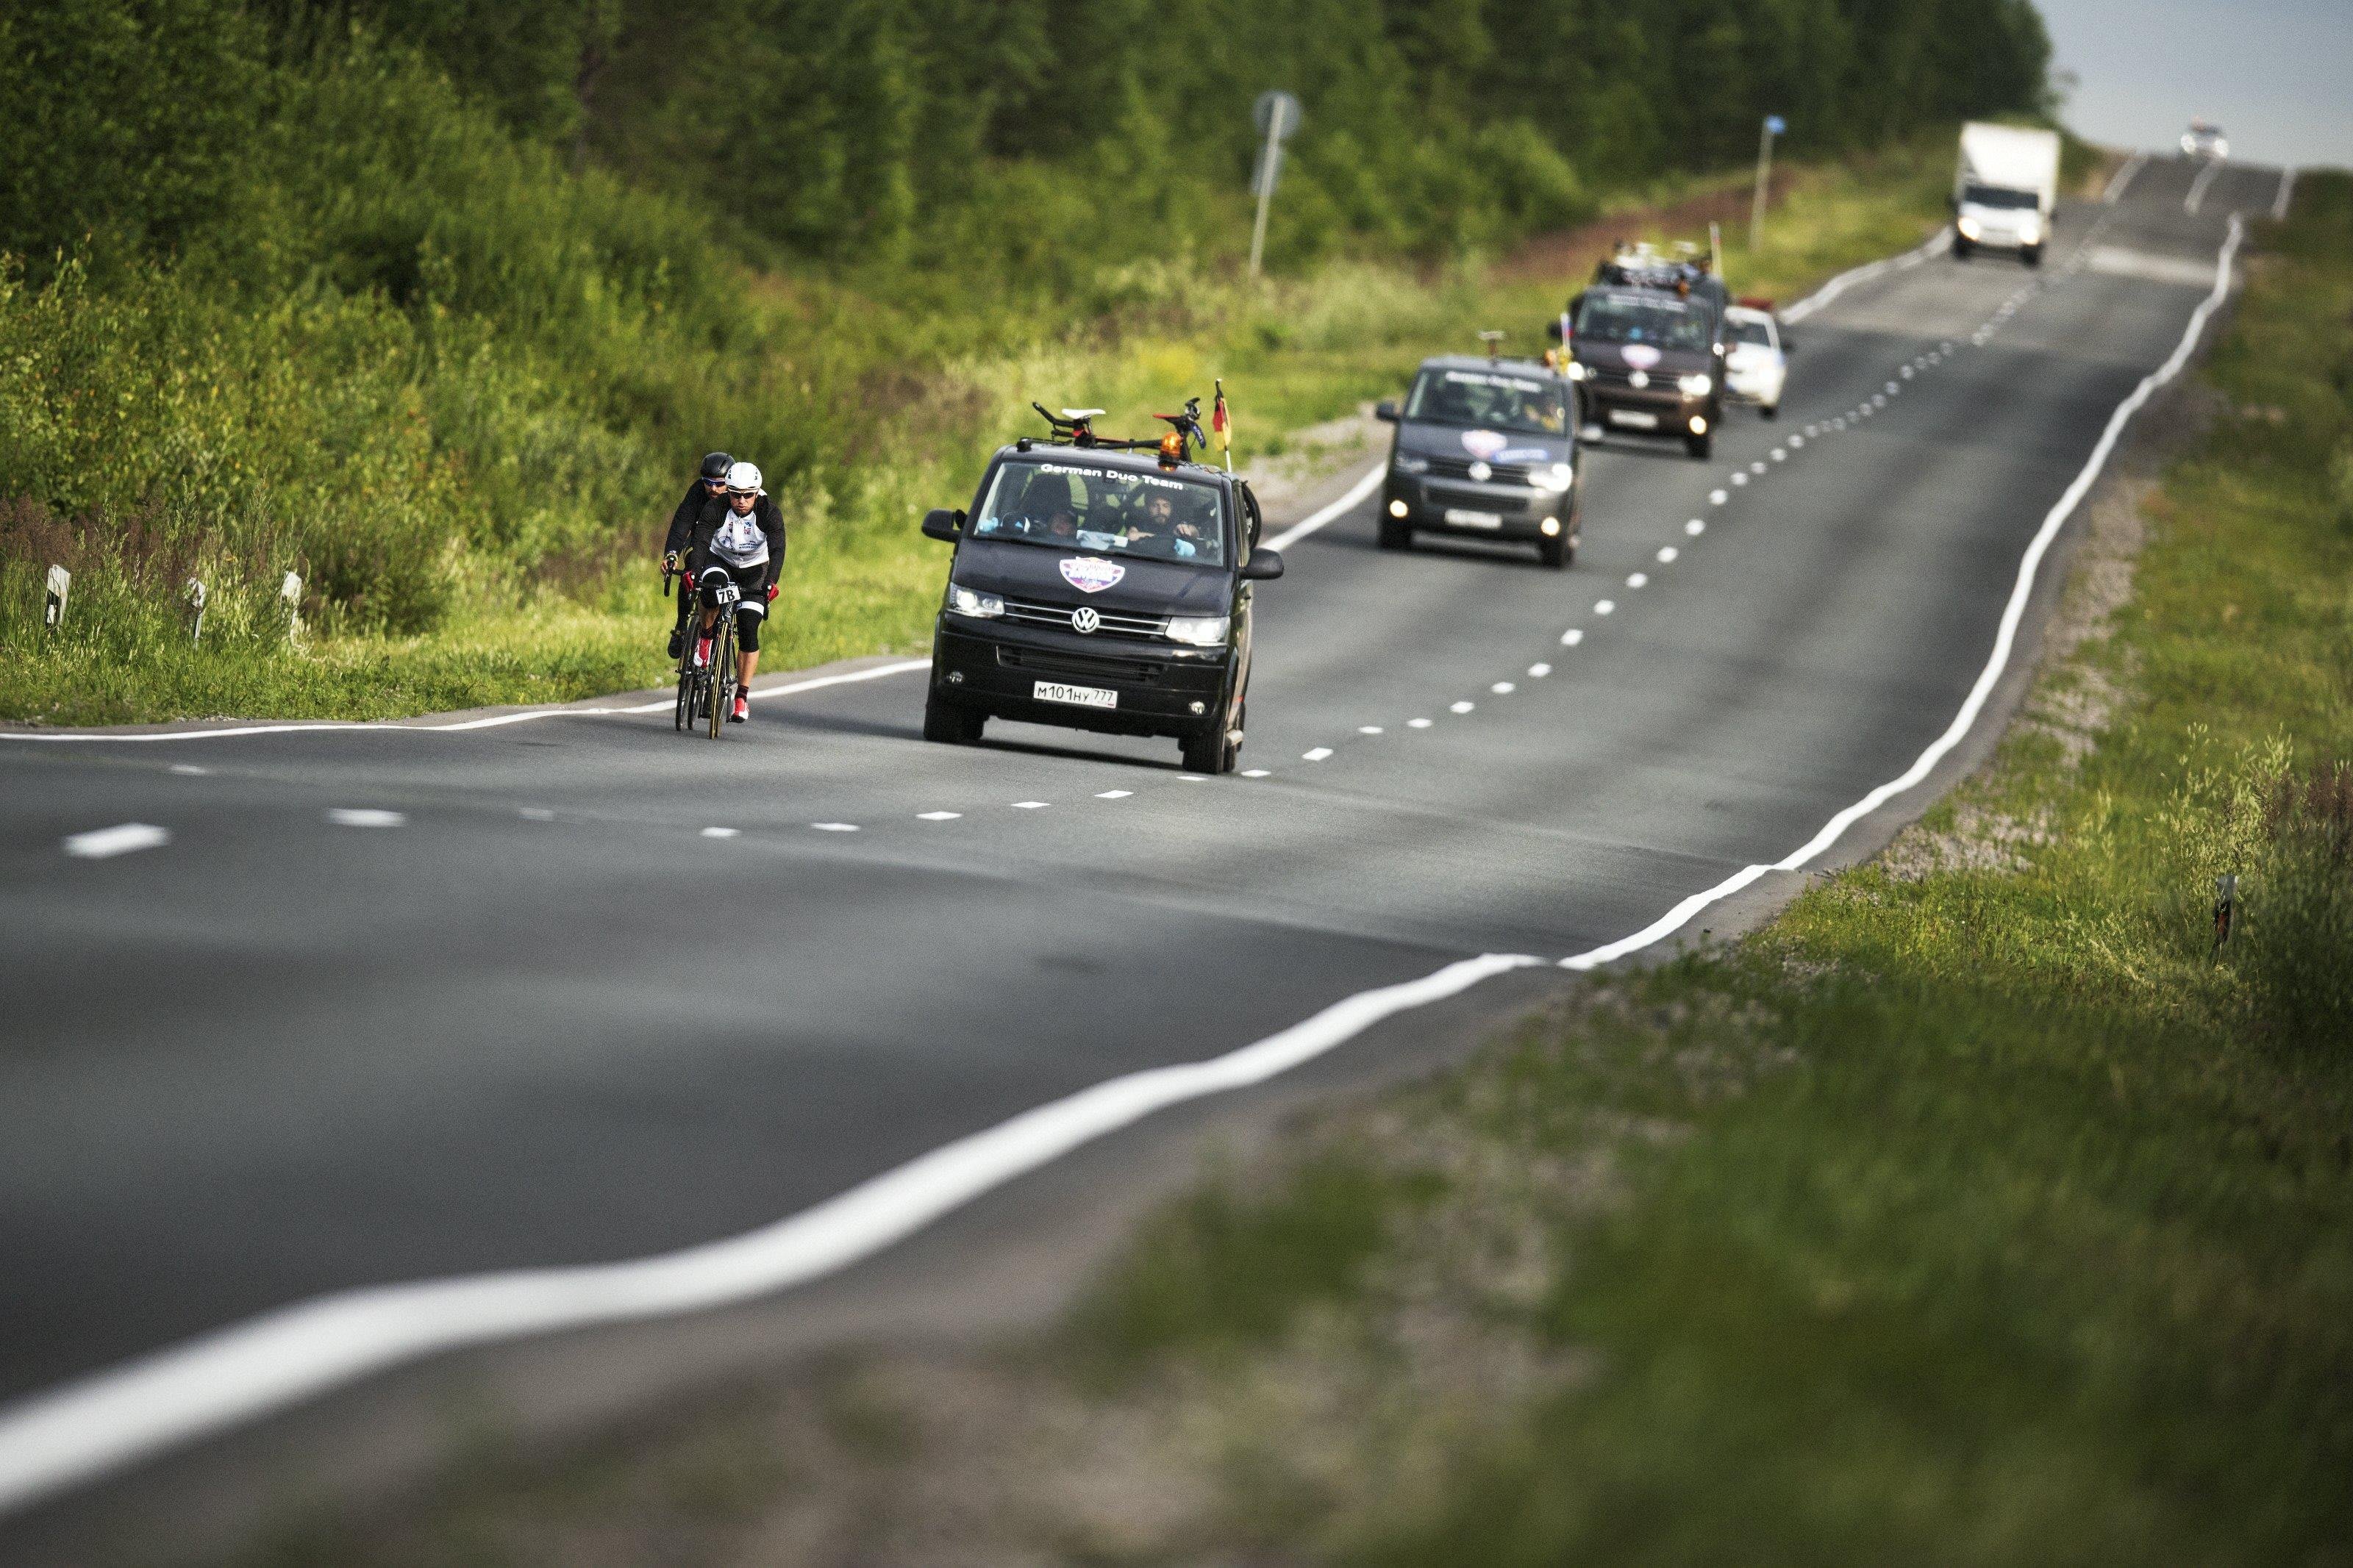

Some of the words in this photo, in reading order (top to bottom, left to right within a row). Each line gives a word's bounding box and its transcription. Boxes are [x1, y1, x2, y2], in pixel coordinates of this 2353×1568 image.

[1040, 464, 1102, 477] German
[1106, 470, 1138, 482] Duo
[1142, 475, 1183, 490] Team
[718, 590, 735, 603] 7B
[1094, 690, 1113, 701] 777
